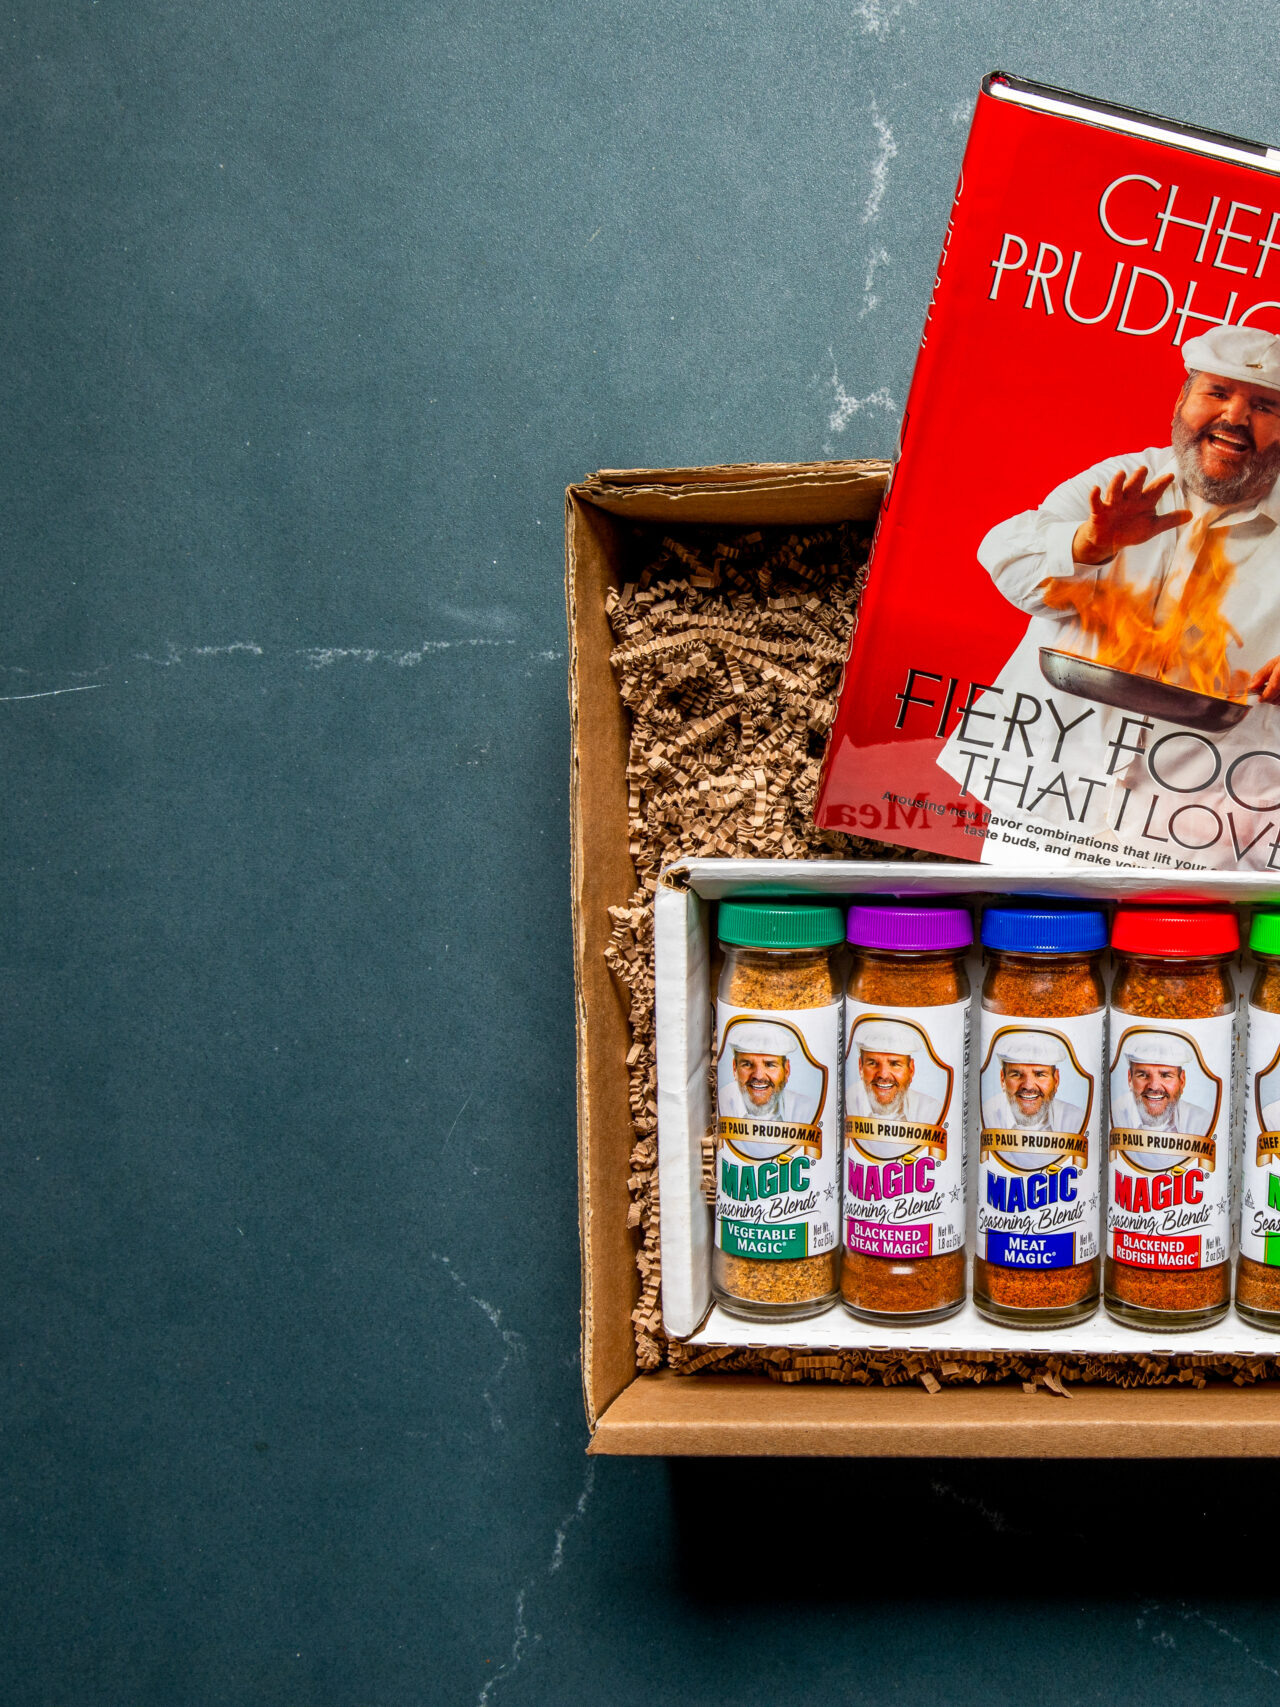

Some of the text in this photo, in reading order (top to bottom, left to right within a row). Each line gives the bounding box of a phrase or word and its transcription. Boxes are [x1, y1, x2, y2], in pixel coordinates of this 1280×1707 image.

[895, 668, 1096, 764] FIERY
[958, 750, 1106, 824] THAT
[882, 791, 947, 816] Arousing
[950, 806, 979, 820] new
[982, 812, 1022, 830] flavor
[1026, 823, 1119, 852] combinations
[1123, 845, 1151, 860] that
[1153, 851, 1172, 865] lift
[964, 824, 999, 840] taste
[1002, 832, 1040, 852] buds,
[1044, 844, 1072, 857] and
[1074, 850, 1111, 866] make
[728, 1122, 749, 1135] PAUL
[752, 1124, 821, 1143] PRUDHOMME
[855, 1122, 875, 1135] PAUL
[878, 1124, 946, 1144] PRUDHOMME
[996, 1134, 1018, 1146] PAUL
[1022, 1135, 1087, 1153] PRUDHOMME
[1123, 1133, 1144, 1146] PAUL
[1147, 1136, 1215, 1156] PRUDHOMME
[1260, 1136, 1279, 1150] CHEF
[728, 1222, 796, 1240] VEGETABLE
[854, 1222, 921, 1241] BLACKENED
[850, 1235, 880, 1252] STEAK
[1009, 1237, 1046, 1251] MEAT
[1123, 1234, 1185, 1253] BLACKENED
[1116, 1245, 1155, 1265] REDFISH
